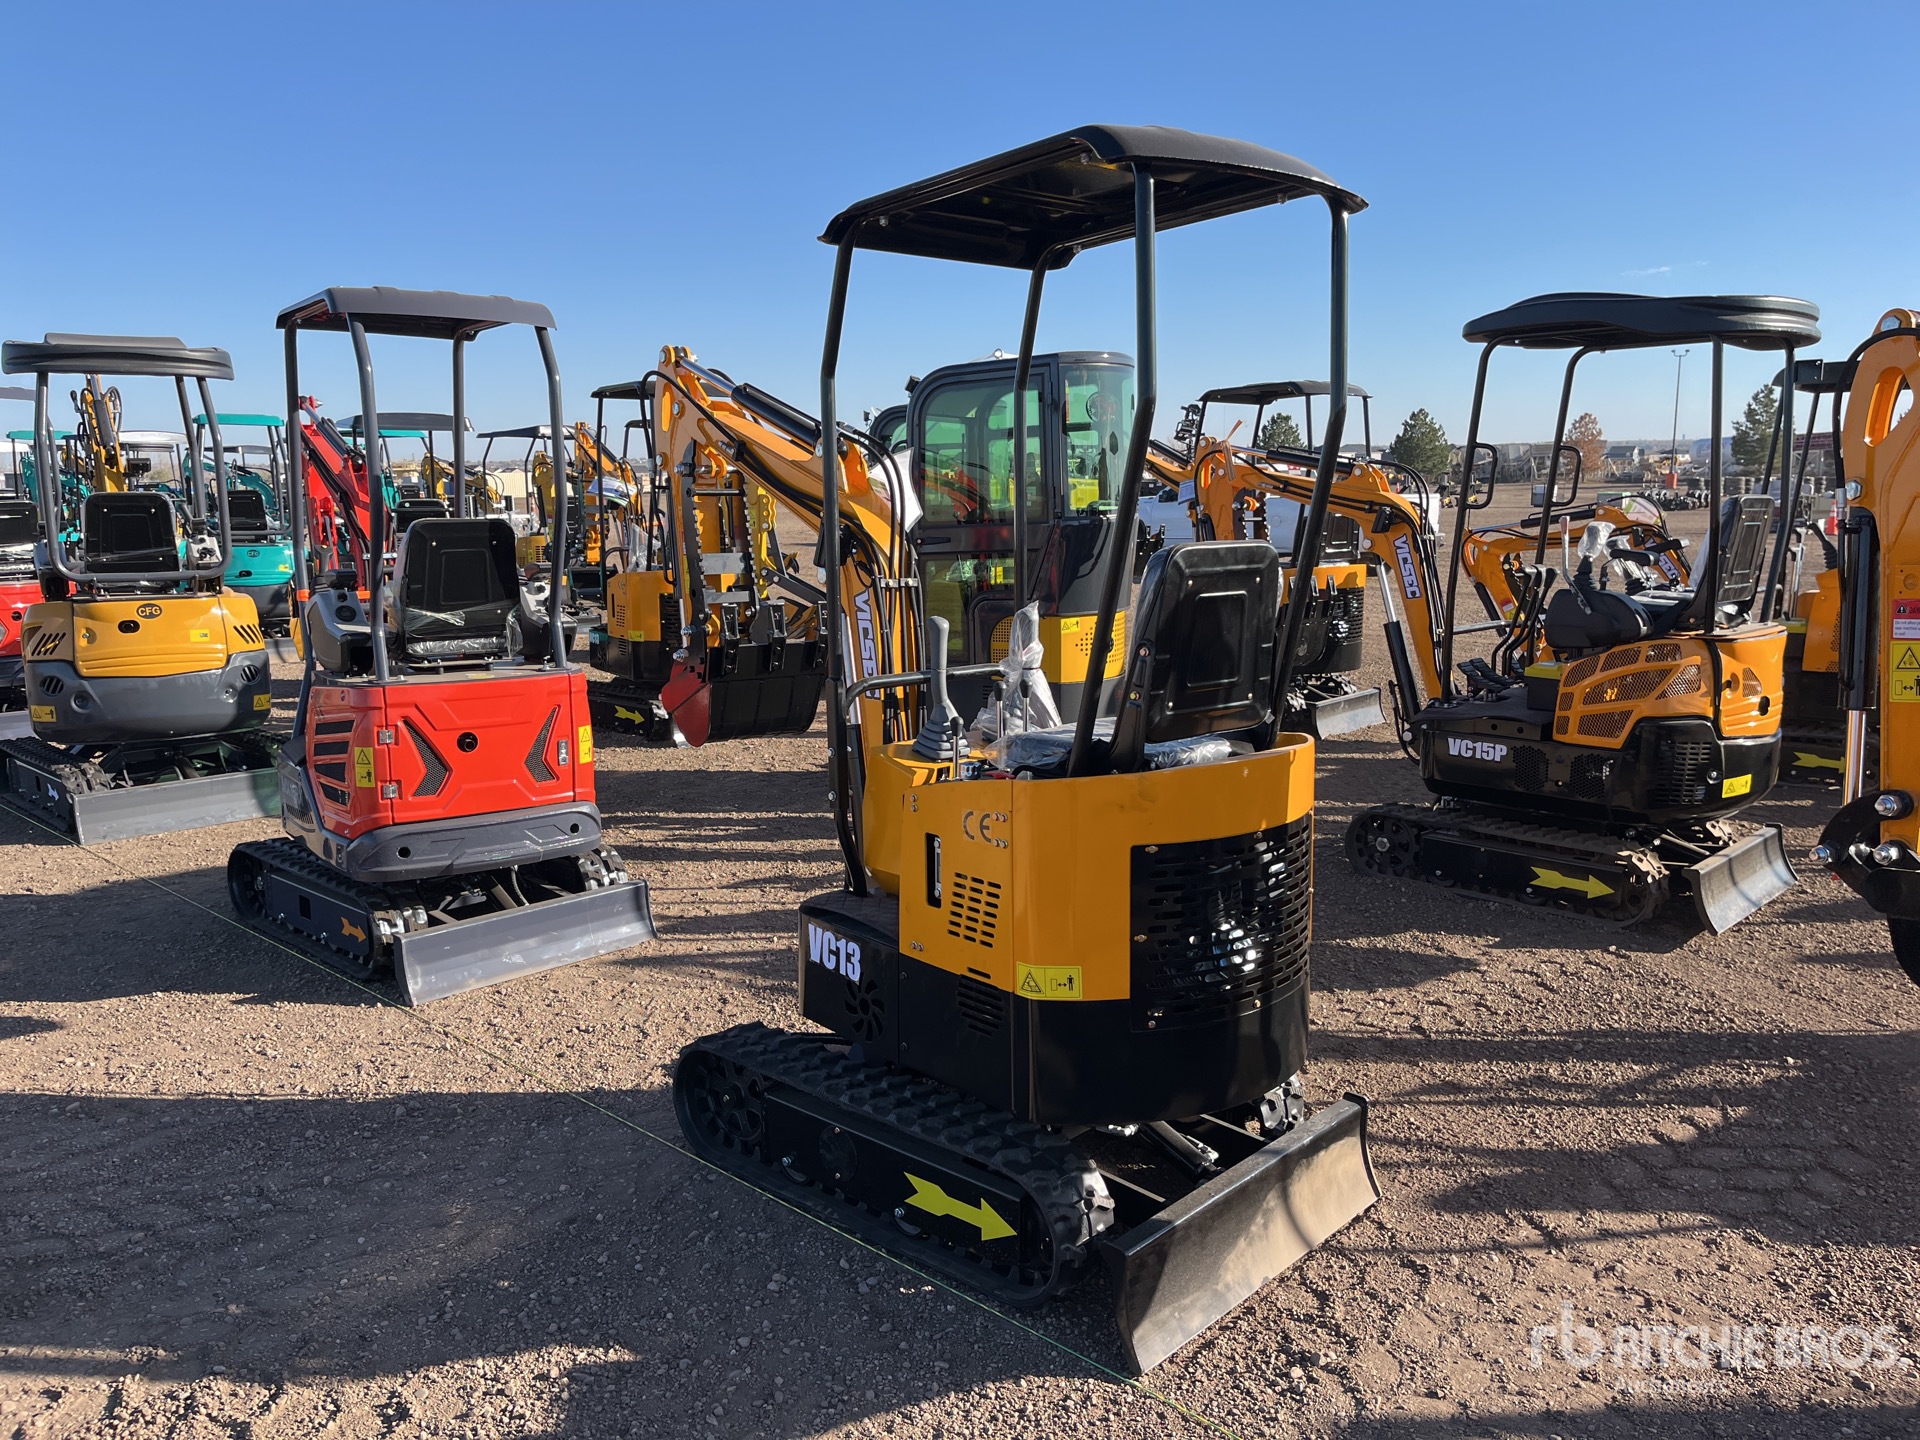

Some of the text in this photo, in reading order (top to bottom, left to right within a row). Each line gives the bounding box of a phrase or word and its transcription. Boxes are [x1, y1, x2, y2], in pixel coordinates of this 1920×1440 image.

[1393, 533, 1421, 599] VICSEC
[1644, 537, 1681, 579] VSEC
[138, 606, 160, 616] CFG
[1448, 738, 1507, 761] VC15P
[963, 811, 991, 843] CE
[808, 923, 861, 981] VC13
